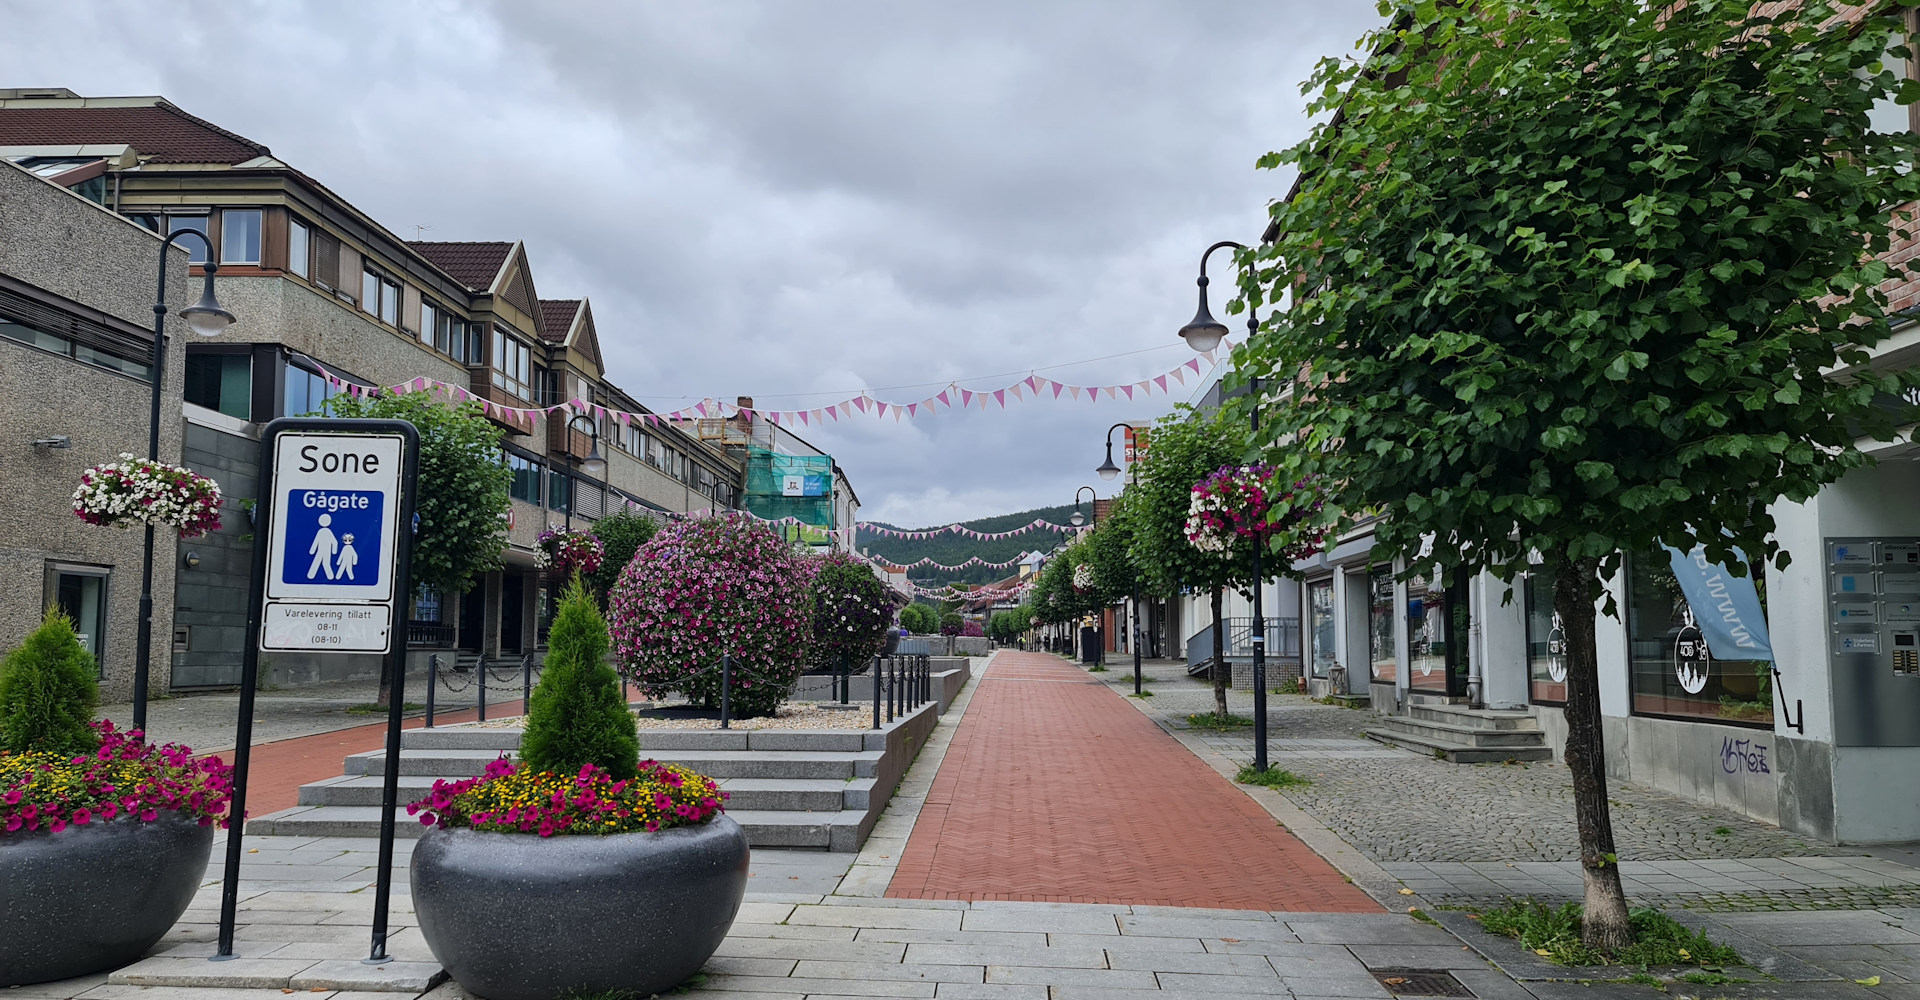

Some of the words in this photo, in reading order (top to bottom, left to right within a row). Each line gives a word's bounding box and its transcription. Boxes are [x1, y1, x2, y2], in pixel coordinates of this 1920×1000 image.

[298, 445, 379, 474] Sone
[303, 491, 369, 512] Gågate
[285, 608, 343, 620] Varelevering
[348, 610, 371, 619] tillatt
[317, 623, 337, 631] 08-11
[311, 635, 341, 644] (08-10)
